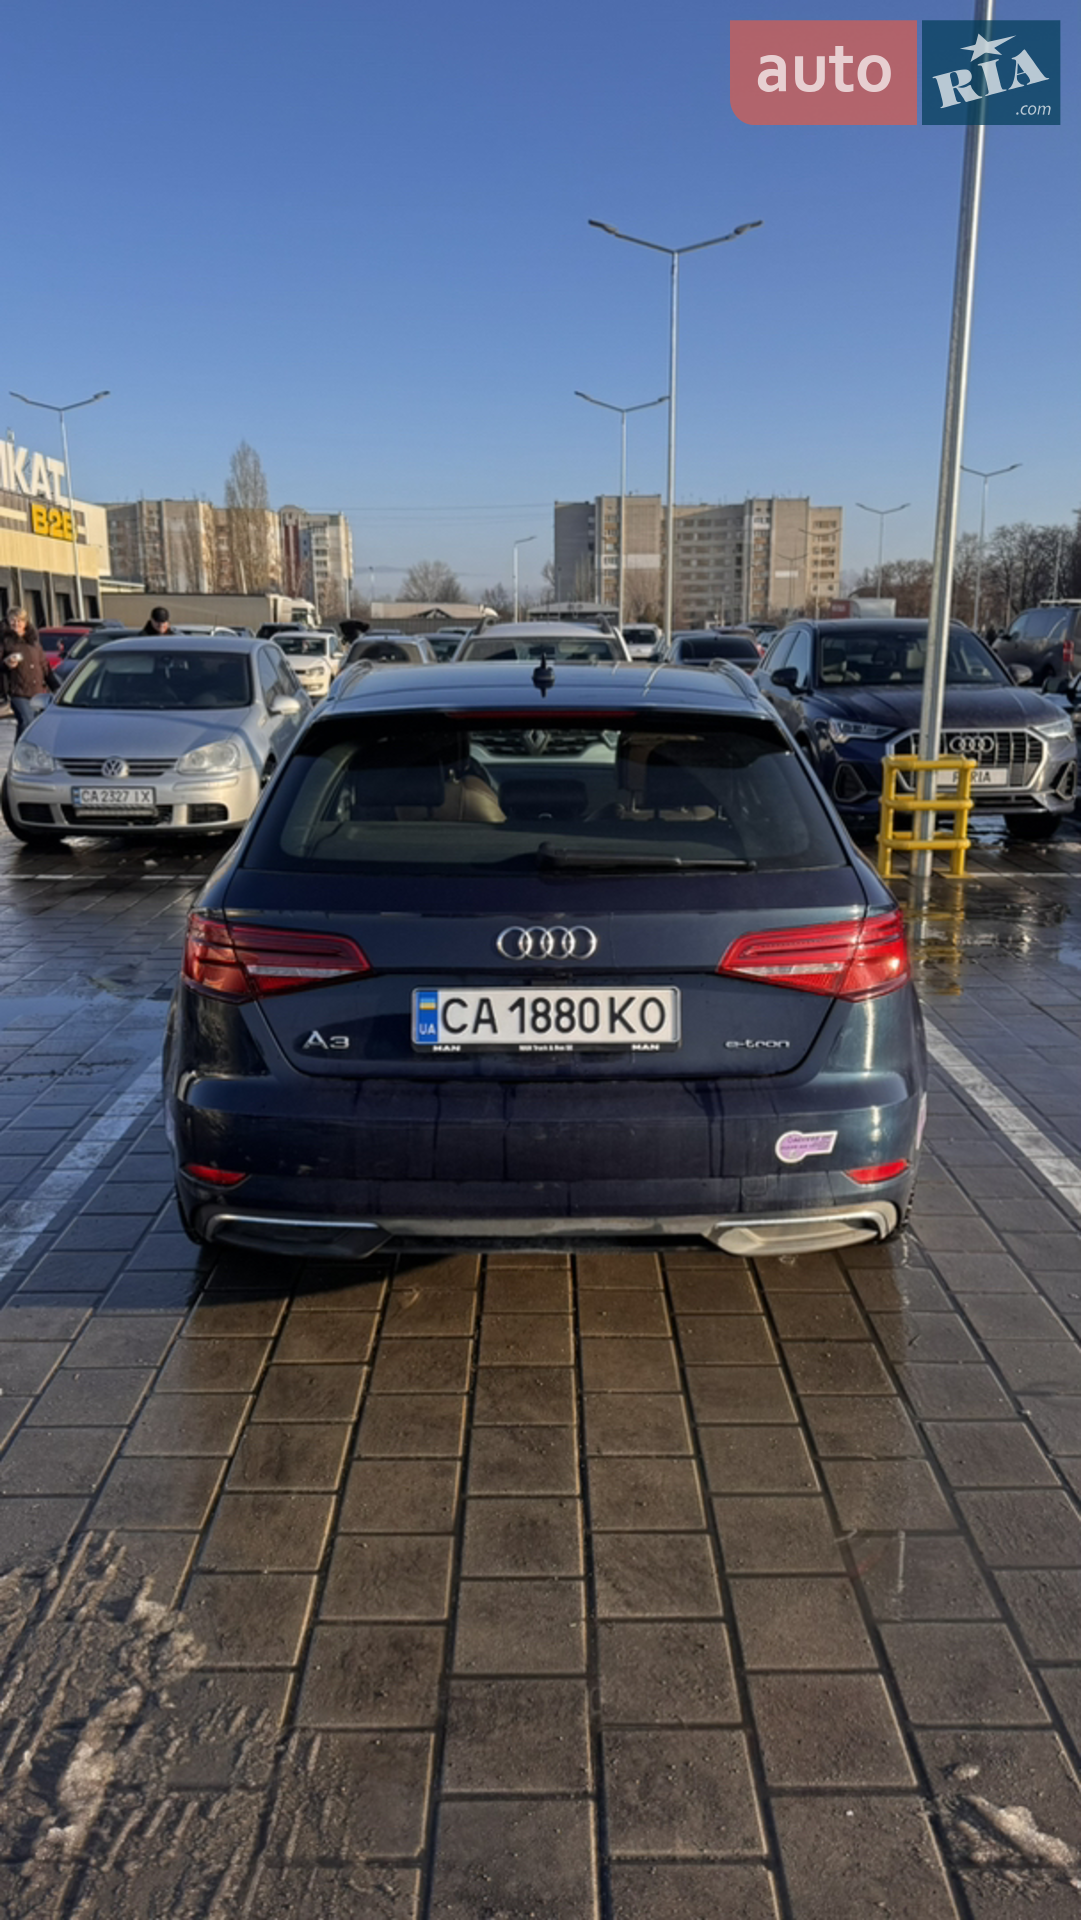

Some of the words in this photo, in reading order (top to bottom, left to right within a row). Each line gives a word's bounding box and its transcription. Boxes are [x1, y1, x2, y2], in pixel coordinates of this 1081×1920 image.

[441, 997, 498, 1034] CA
[508, 996, 600, 1034] 1880
[609, 996, 666, 1034] KO
[419, 1023, 436, 1035] UA
[302, 1030, 350, 1049] A3
[725, 1039, 790, 1048] e-tron
